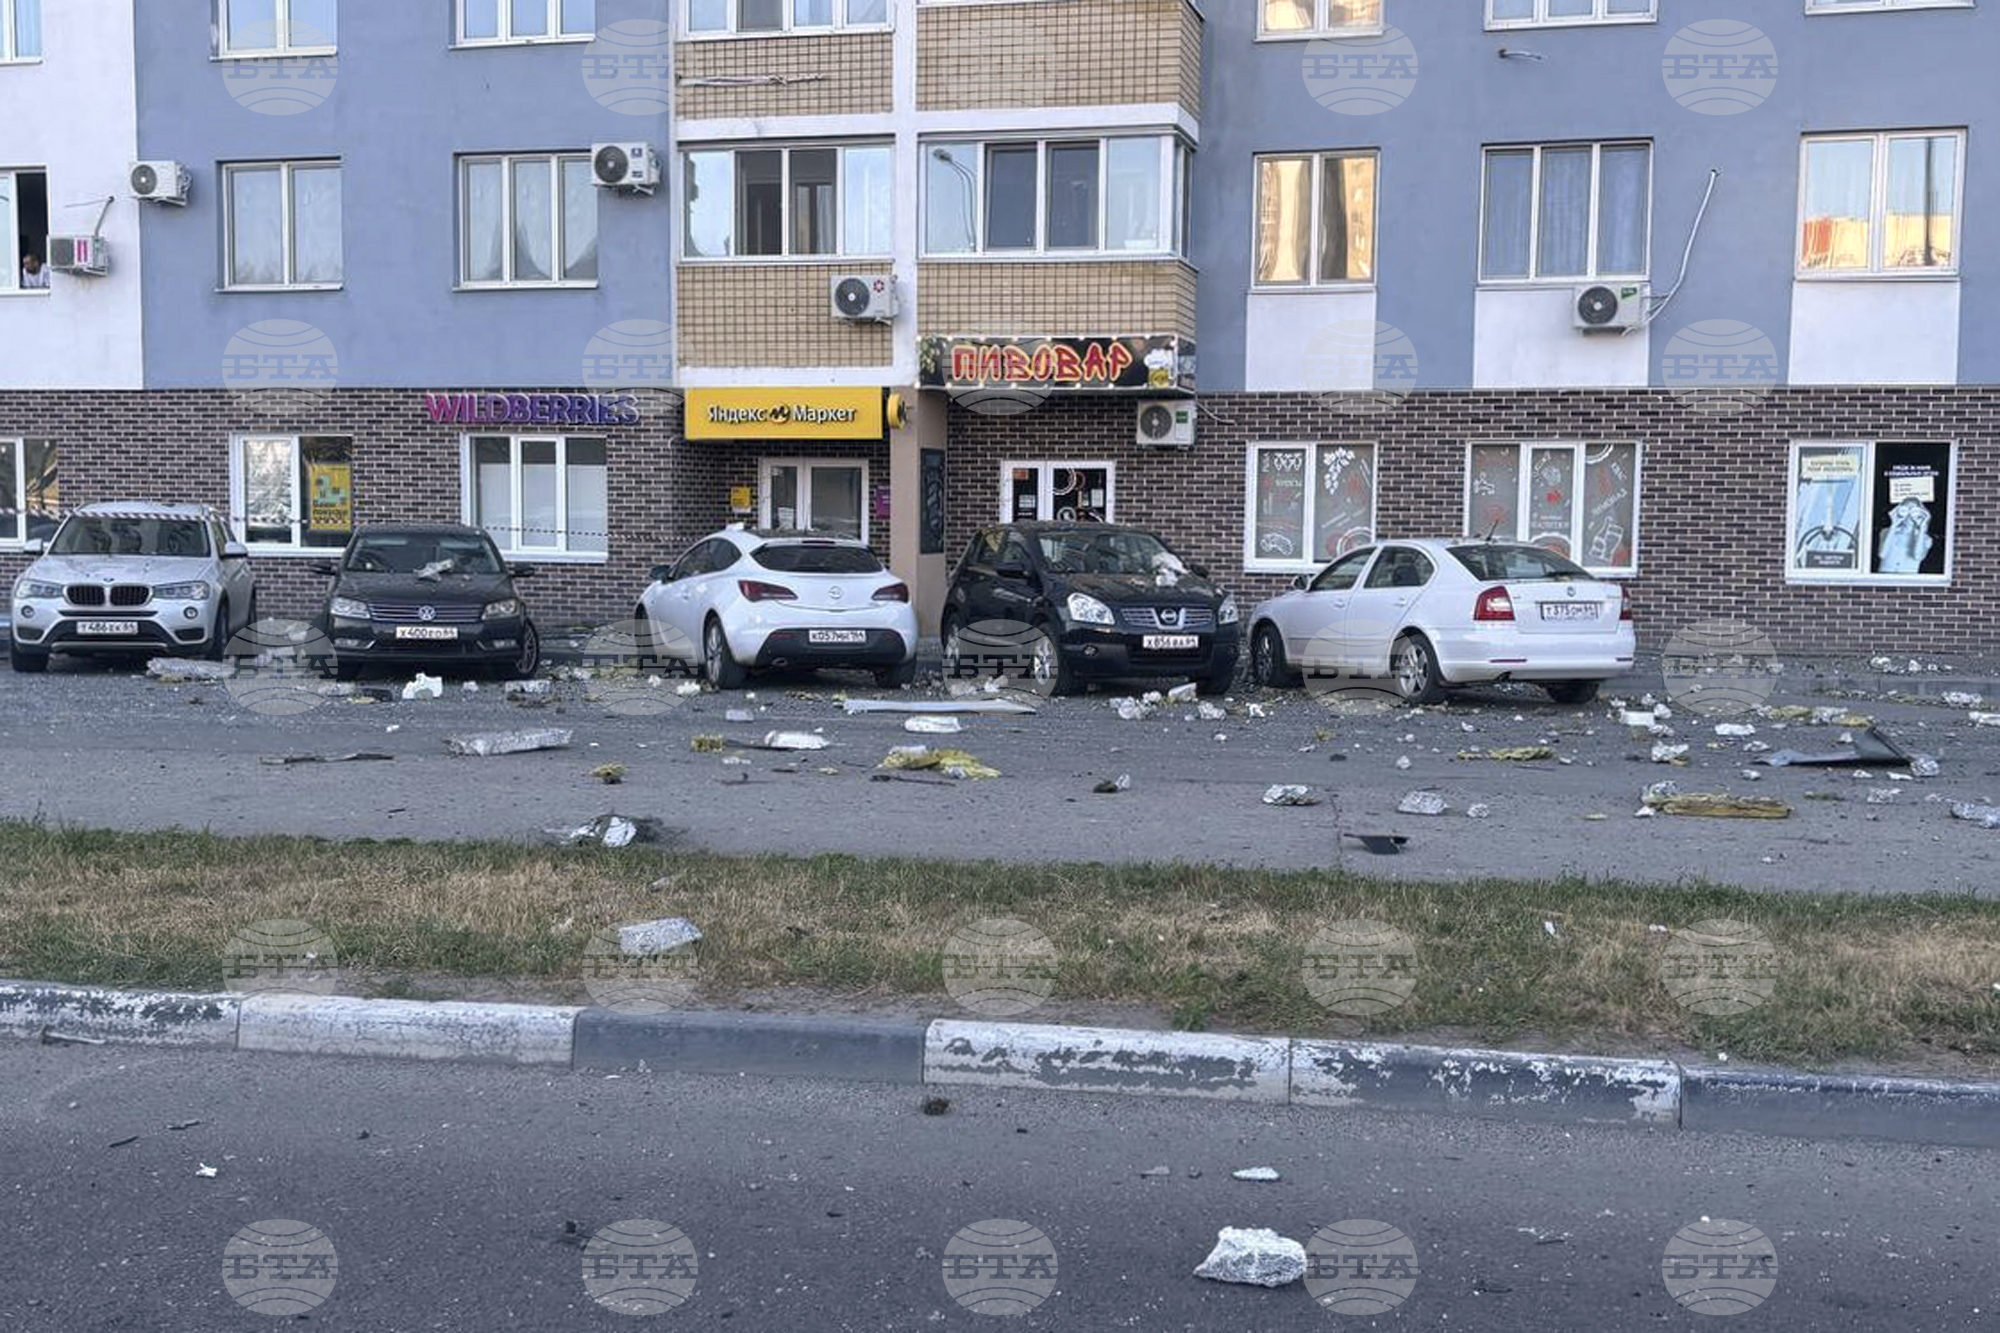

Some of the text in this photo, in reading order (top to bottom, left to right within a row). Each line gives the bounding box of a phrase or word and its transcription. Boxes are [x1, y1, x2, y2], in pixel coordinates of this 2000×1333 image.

[952, 341, 1132, 382] ПИВОВАР
[425, 392, 640, 426] WILDBERRIES
[708, 405, 856, 424] Яндекс Маркет
